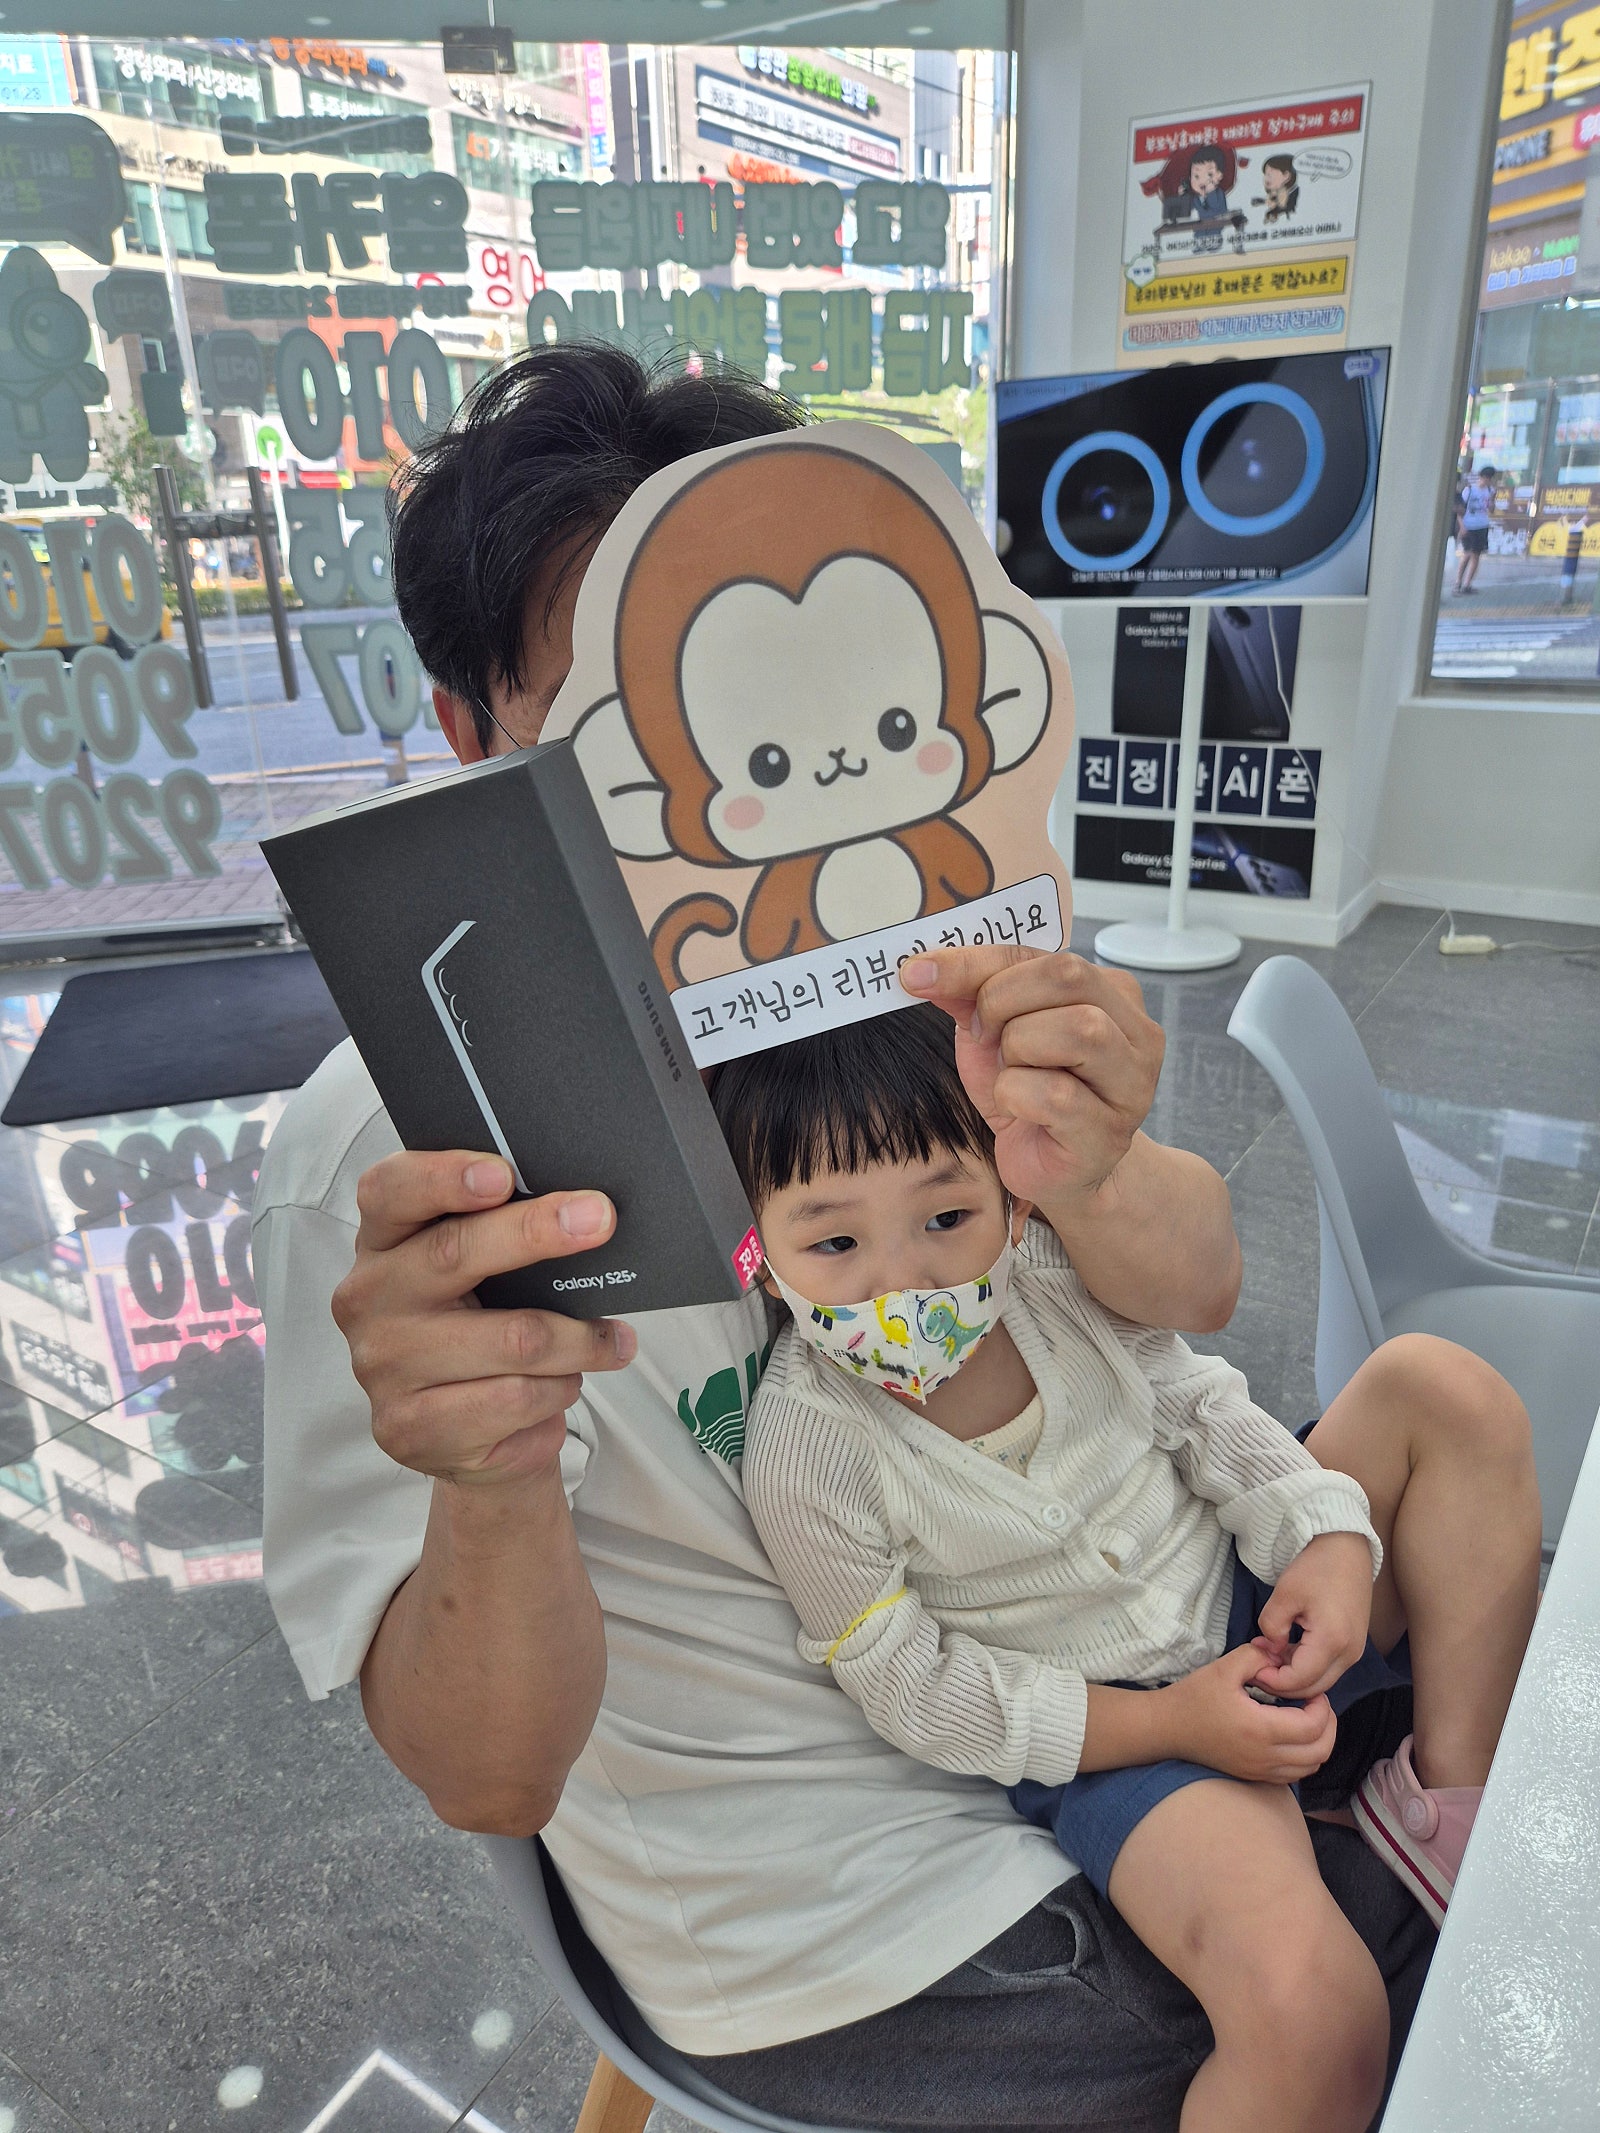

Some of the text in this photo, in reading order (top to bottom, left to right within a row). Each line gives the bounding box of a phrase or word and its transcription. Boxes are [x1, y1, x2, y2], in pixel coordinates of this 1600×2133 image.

[1270, 267, 1338, 291] 괜찮나요?
[1121, 851, 1162, 869] Galaxy
[691, 971, 824, 1041] 고객님의
[638, 980, 682, 1082] SAMSUNG
[552, 1269, 638, 1292] Galaxy S25+
